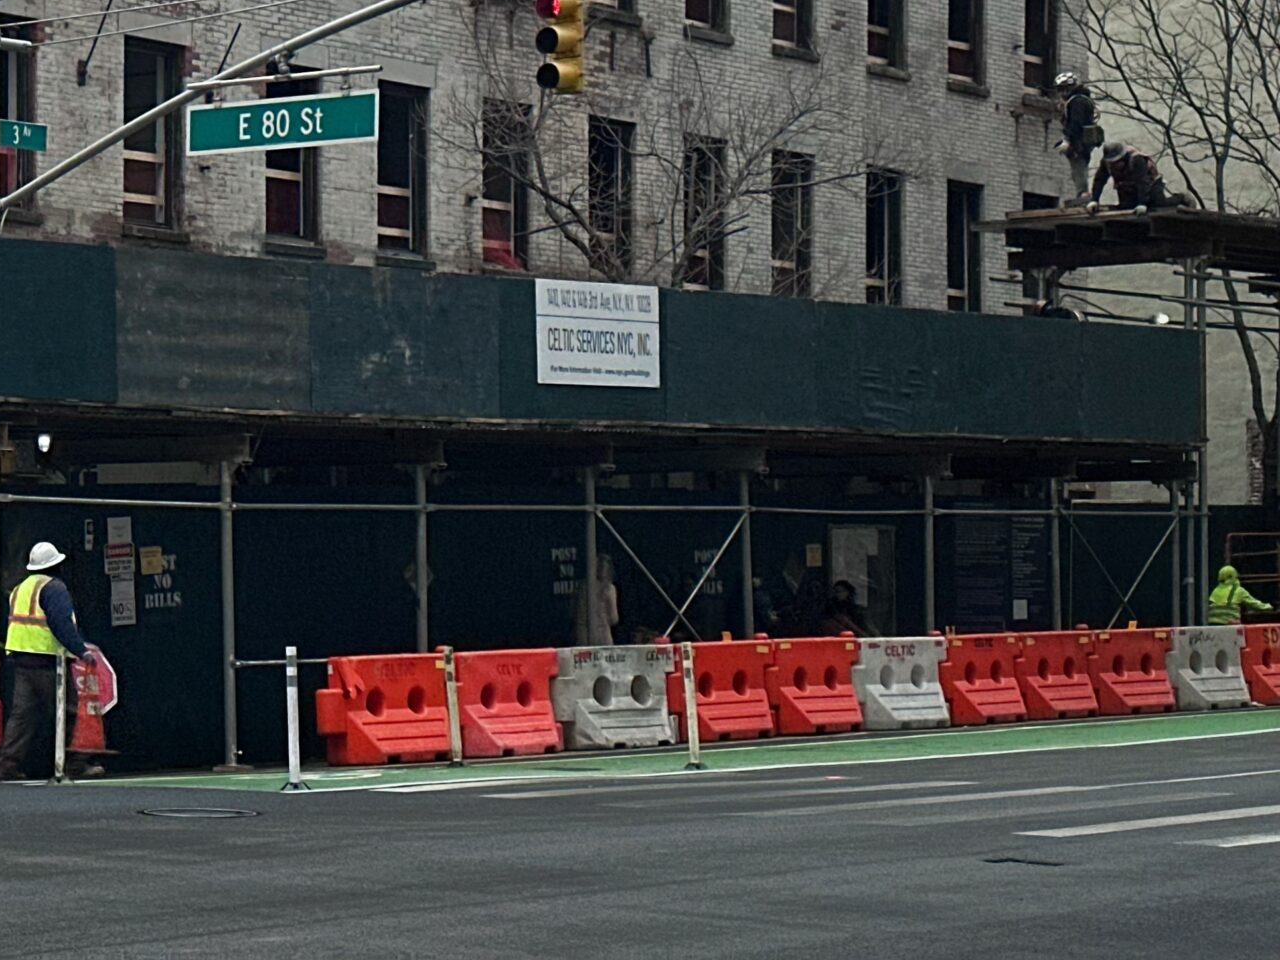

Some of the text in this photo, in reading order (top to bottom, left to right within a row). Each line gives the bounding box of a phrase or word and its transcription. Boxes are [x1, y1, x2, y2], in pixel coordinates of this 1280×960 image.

[239, 106, 324, 141] E 80 St
[12, 125, 32, 145] 3 Av
[588, 290, 598, 310] 3rd
[547, 327, 652, 358] CELTIC SERVICES NYC, INC.
[551, 547, 578, 562] POST
[559, 563, 575, 578] NO
[153, 572, 173, 590] NO
[112, 602, 124, 615] NO
[144, 591, 184, 609] BILLS
[885, 644, 916, 657] CELTIC
